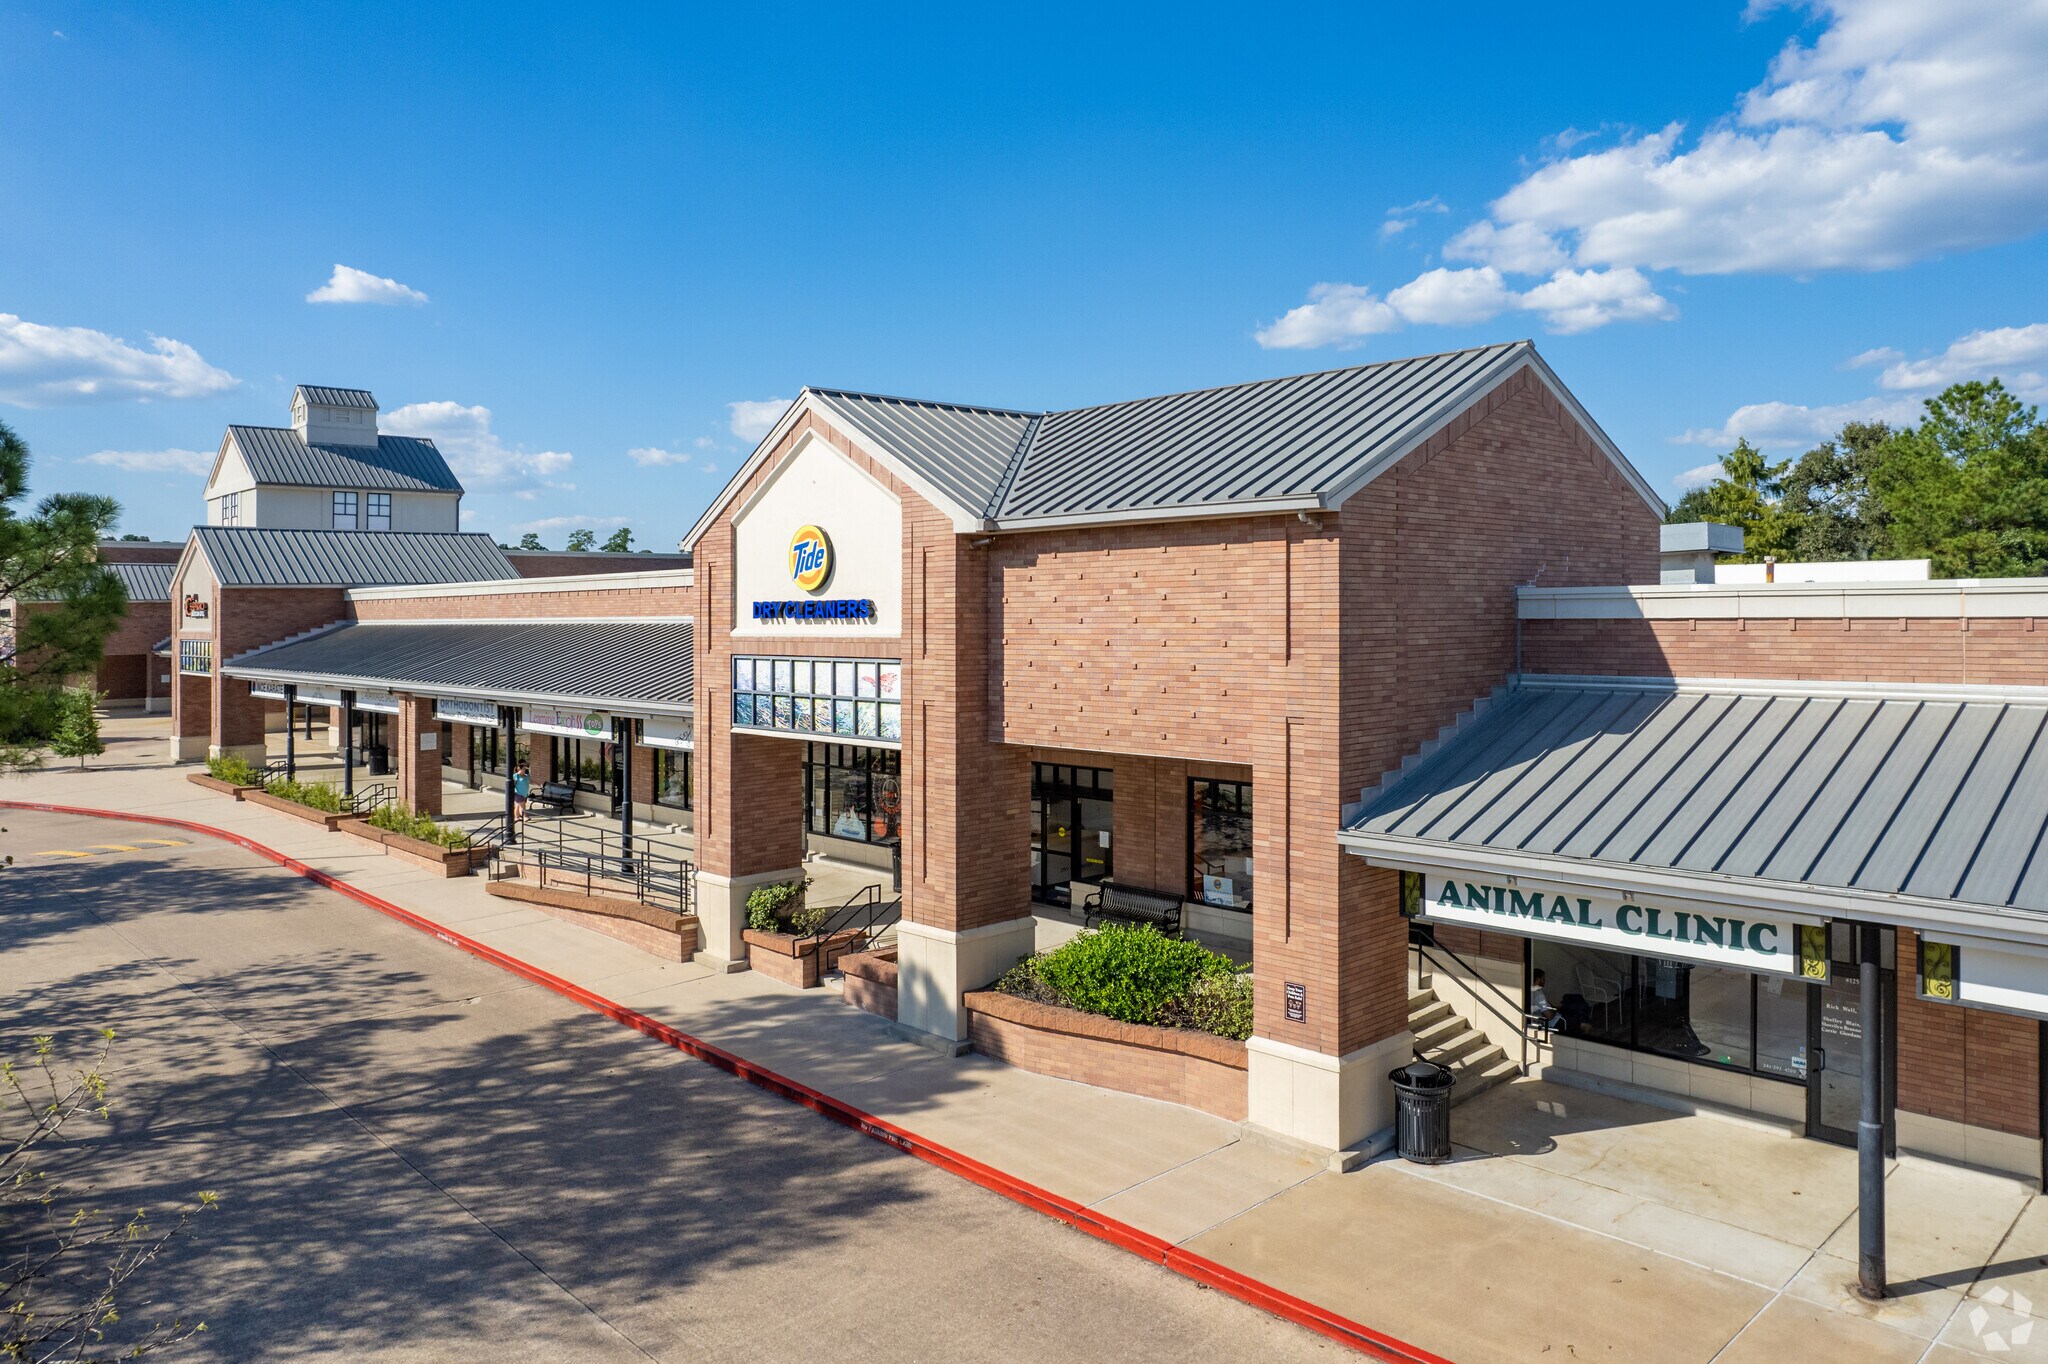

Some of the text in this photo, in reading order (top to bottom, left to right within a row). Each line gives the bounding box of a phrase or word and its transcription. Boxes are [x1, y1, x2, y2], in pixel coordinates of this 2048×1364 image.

[793, 541, 825, 580] Tide
[753, 599, 870, 619] DRY CLEANERS
[440, 699, 495, 713] ORTHODONTIST
[529, 709, 556, 729] Learning
[1436, 879, 1778, 956] ANIMAL CLINIC
